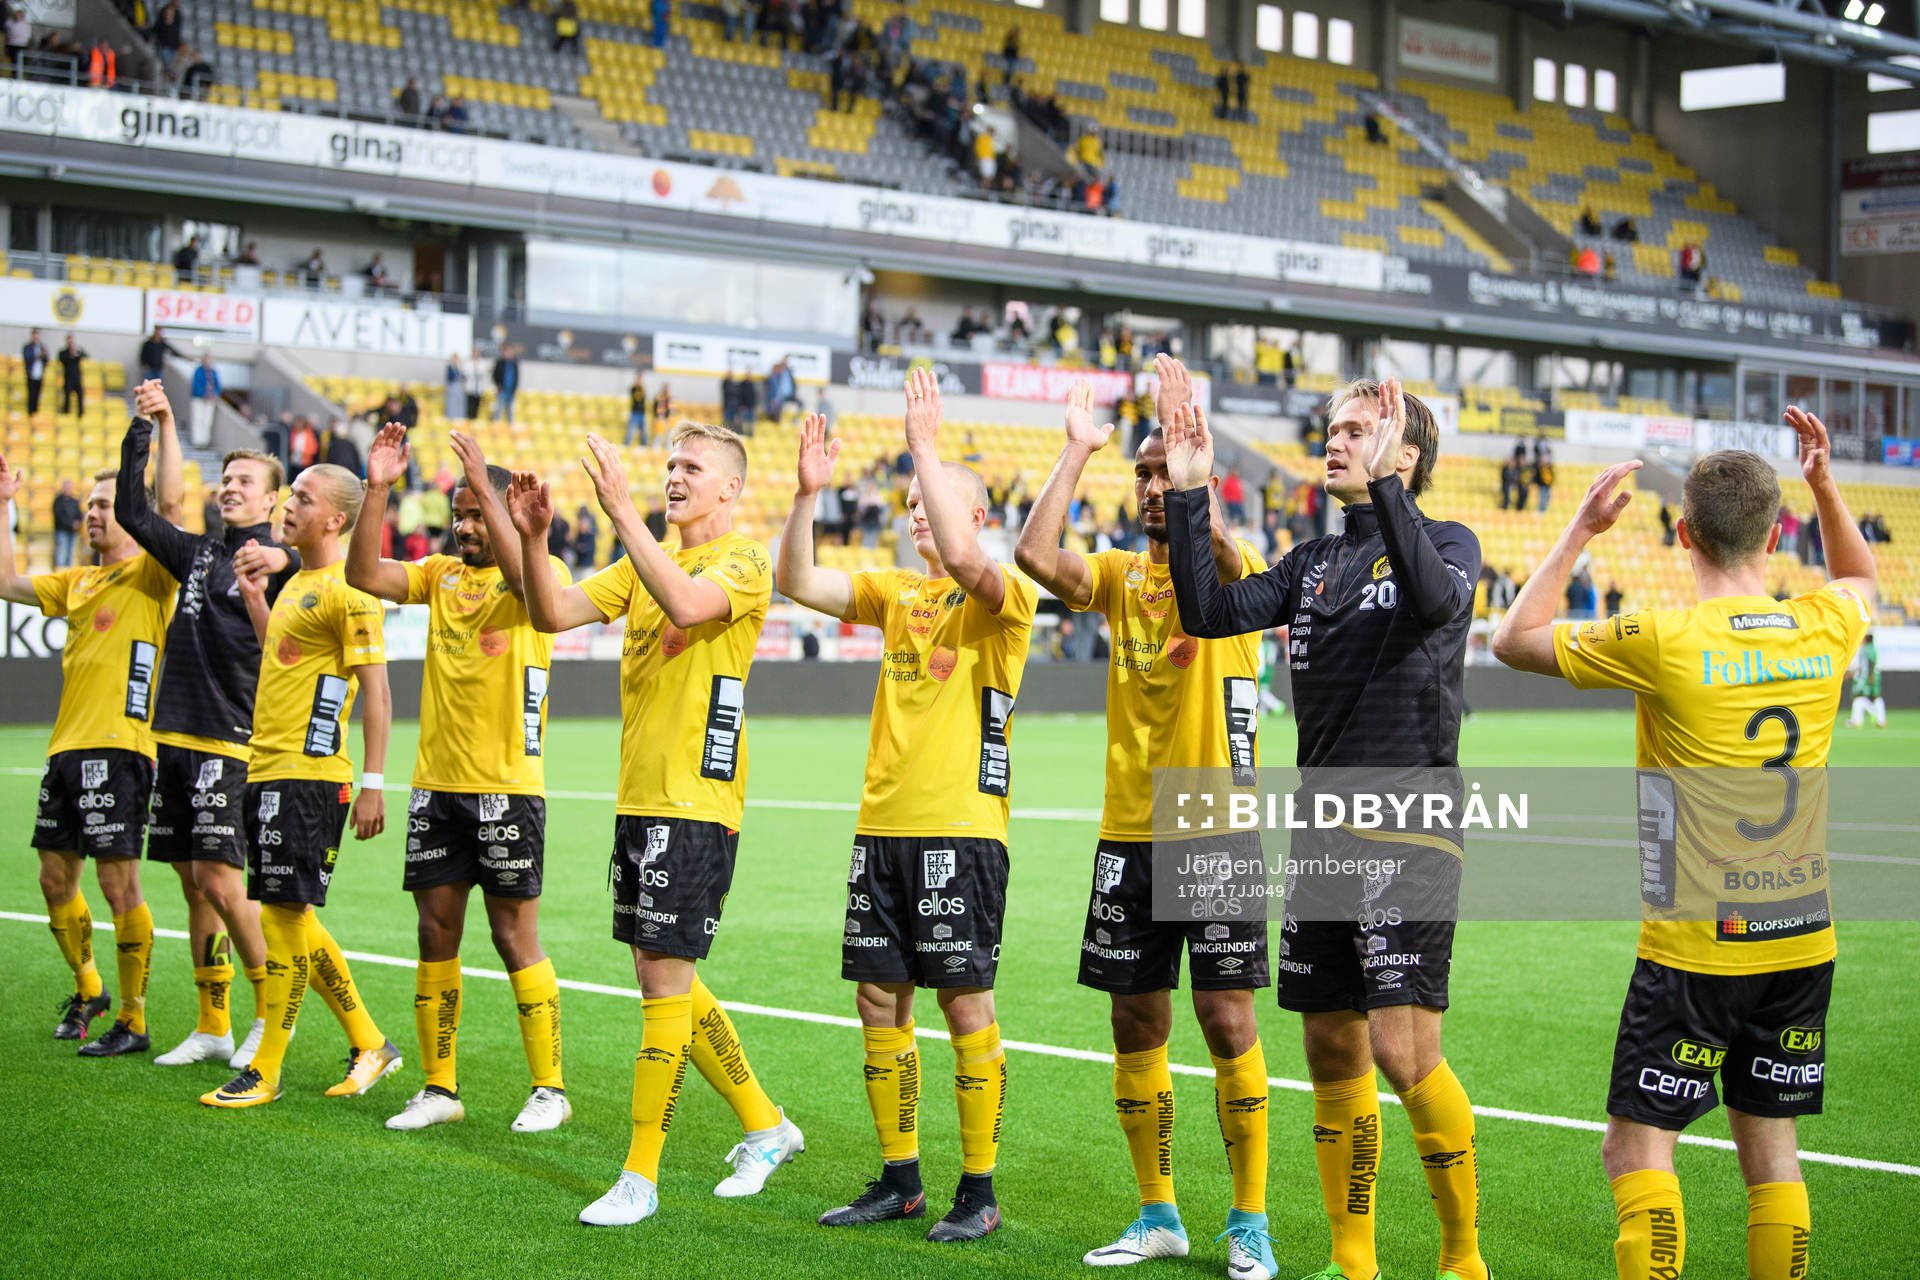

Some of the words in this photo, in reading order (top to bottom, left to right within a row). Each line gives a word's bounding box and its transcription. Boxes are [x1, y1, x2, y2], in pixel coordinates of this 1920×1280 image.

[154, 295, 254, 324] SPEED
[294, 301, 445, 349] AVENTI
[1360, 581, 1397, 610] 20
[1700, 650, 1833, 686] Folksam
[1735, 705, 1800, 842] 3
[478, 823, 520, 842] ellos
[927, 853, 949, 864] EFF
[927, 863, 952, 875] EKT
[1099, 855, 1118, 869] EFF
[928, 875, 941, 886] IV
[918, 891, 965, 916] ellos
[1191, 894, 1242, 918] ellos
[1749, 915, 1804, 933] OLOFSSON
[1805, 910, 1827, 925] BYGG
[309, 947, 358, 1013] SPRINGYARD
[1219, 968, 1242, 976] umbro
[1378, 982, 1402, 991] umbro
[281, 955, 308, 1031] SPRINGYARD
[437, 988, 459, 1060] SPRINGYARD
[698, 1007, 751, 1087] SPRINGYARD
[1678, 1043, 1727, 1068] EAB
[659, 1043, 691, 1134] SPRINGYARD
[895, 1051, 920, 1133] SPRINGYARD
[1778, 1090, 1815, 1102] umbro
[1156, 1090, 1174, 1177] SPRINGYARD
[1346, 1113, 1378, 1216] SPRINGYARD
